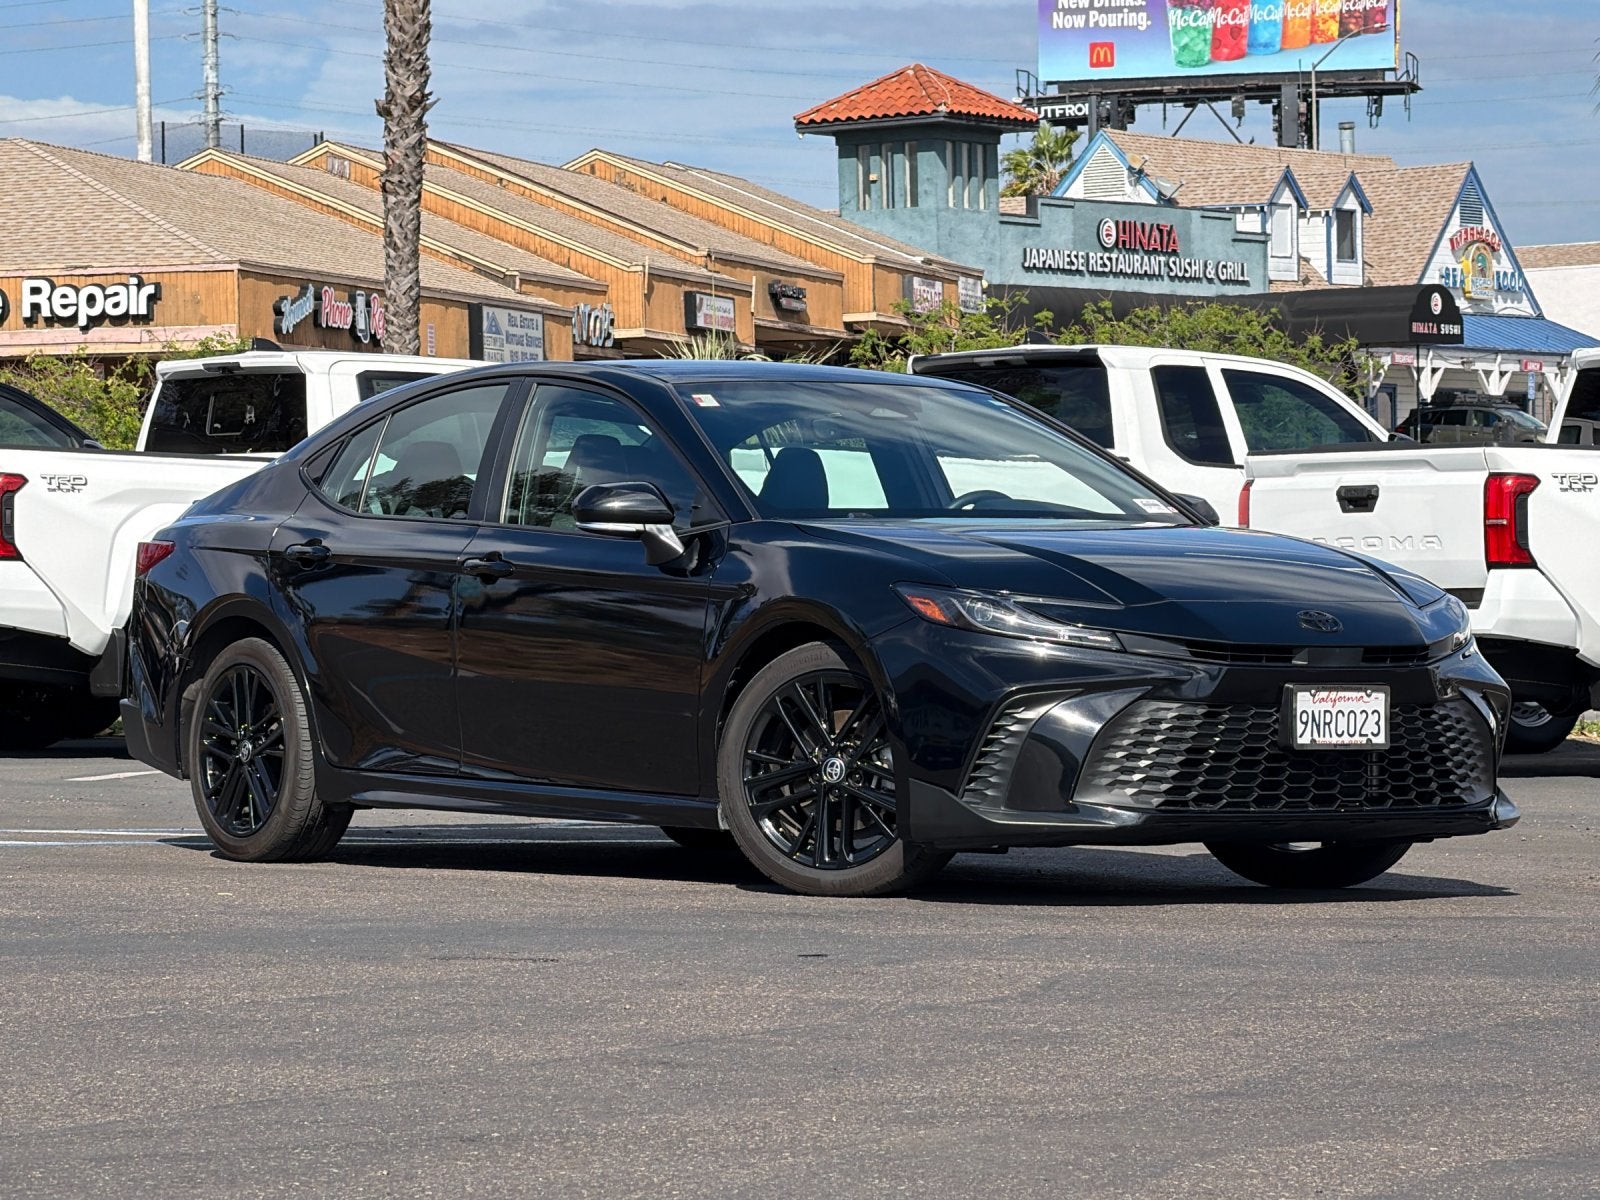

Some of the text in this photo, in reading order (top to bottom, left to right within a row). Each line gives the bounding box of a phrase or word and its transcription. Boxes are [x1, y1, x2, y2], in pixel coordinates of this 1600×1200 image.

[1052, 8, 1152, 31] Now Pouring.
[1168, 8, 1213, 30] McCaf
[1211, 6, 1249, 29] McCaf
[1025, 103, 1089, 119] UTFRO
[1117, 219, 1180, 252] HINATA
[1024, 247, 1250, 281] JAPANESE RESTAURANT SUSHI & GRILL
[1444, 267, 1524, 291] SEA FOOD
[22, 277, 155, 327] Repair
[321, 286, 353, 329] Phone
[519, 314, 536, 330] ESTATE
[1411, 322, 1461, 335] HINATA SUSHI
[40, 474, 88, 489] TRD
[1551, 472, 1598, 487] TRD
[1312, 535, 1443, 550] COMA
[1312, 690, 1370, 708] California
[1298, 709, 1381, 738] 9NRC023
